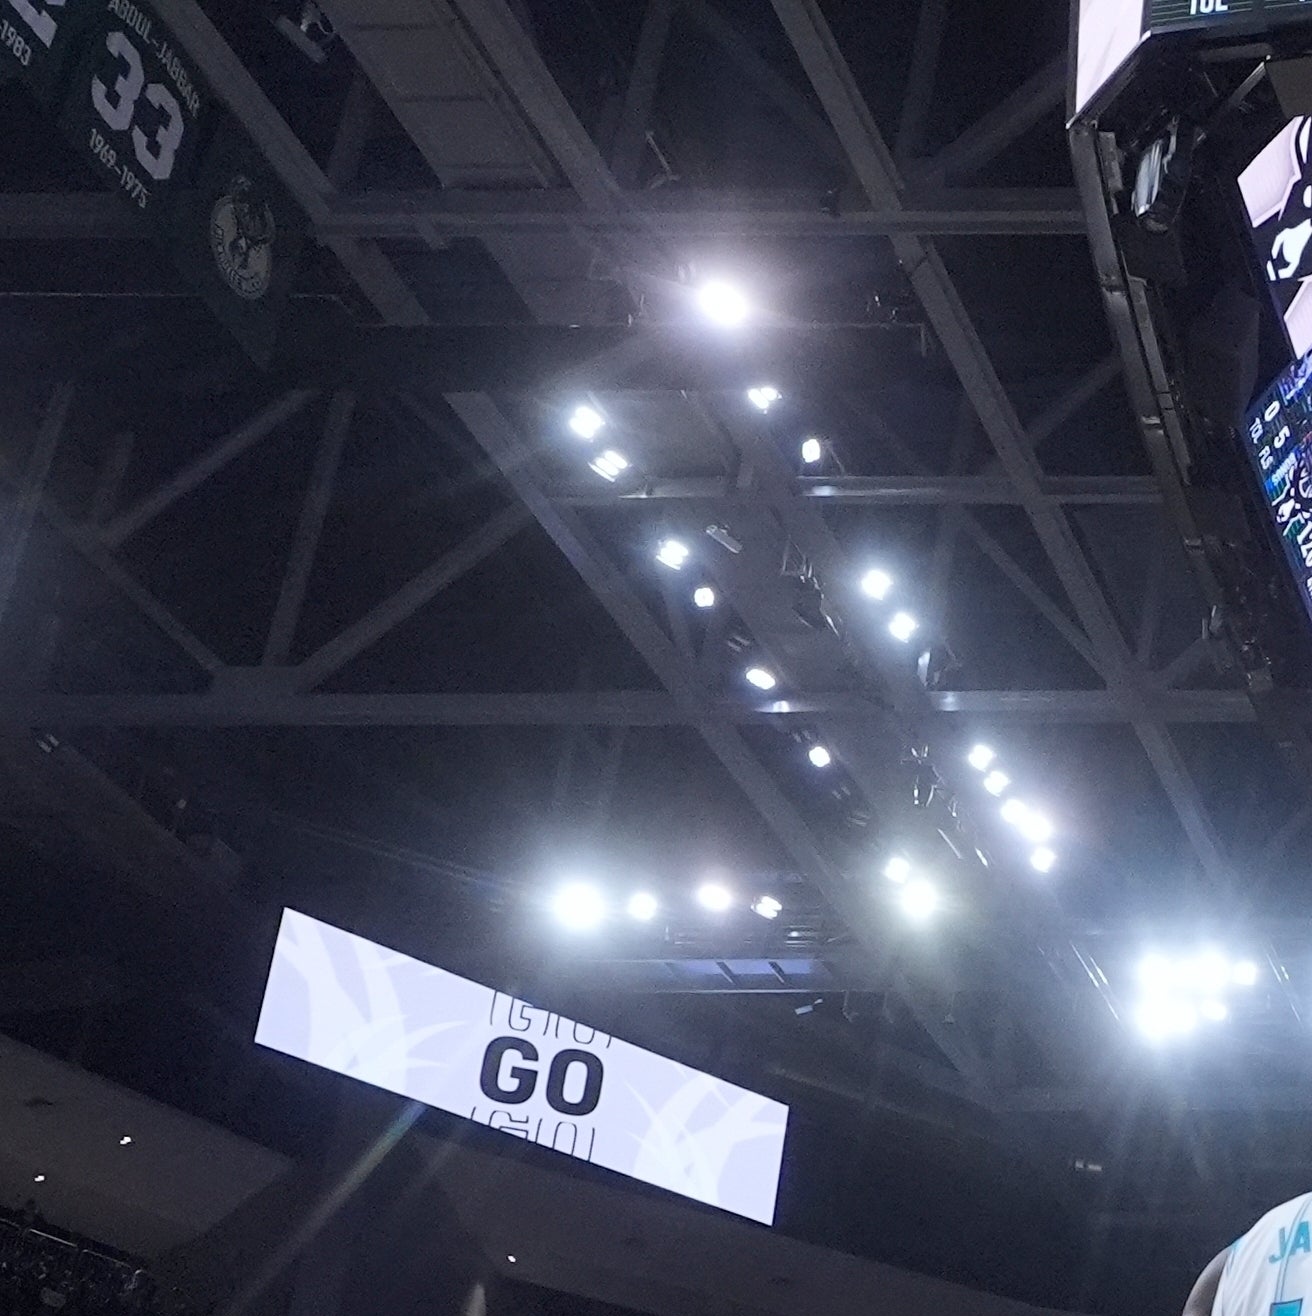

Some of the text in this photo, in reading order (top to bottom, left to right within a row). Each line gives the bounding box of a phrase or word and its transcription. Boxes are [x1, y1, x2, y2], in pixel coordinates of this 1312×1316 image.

[91, 31, 184, 180] 33
[89, 128, 151, 208] 1969-1975
[479, 1035, 604, 1116] GO
